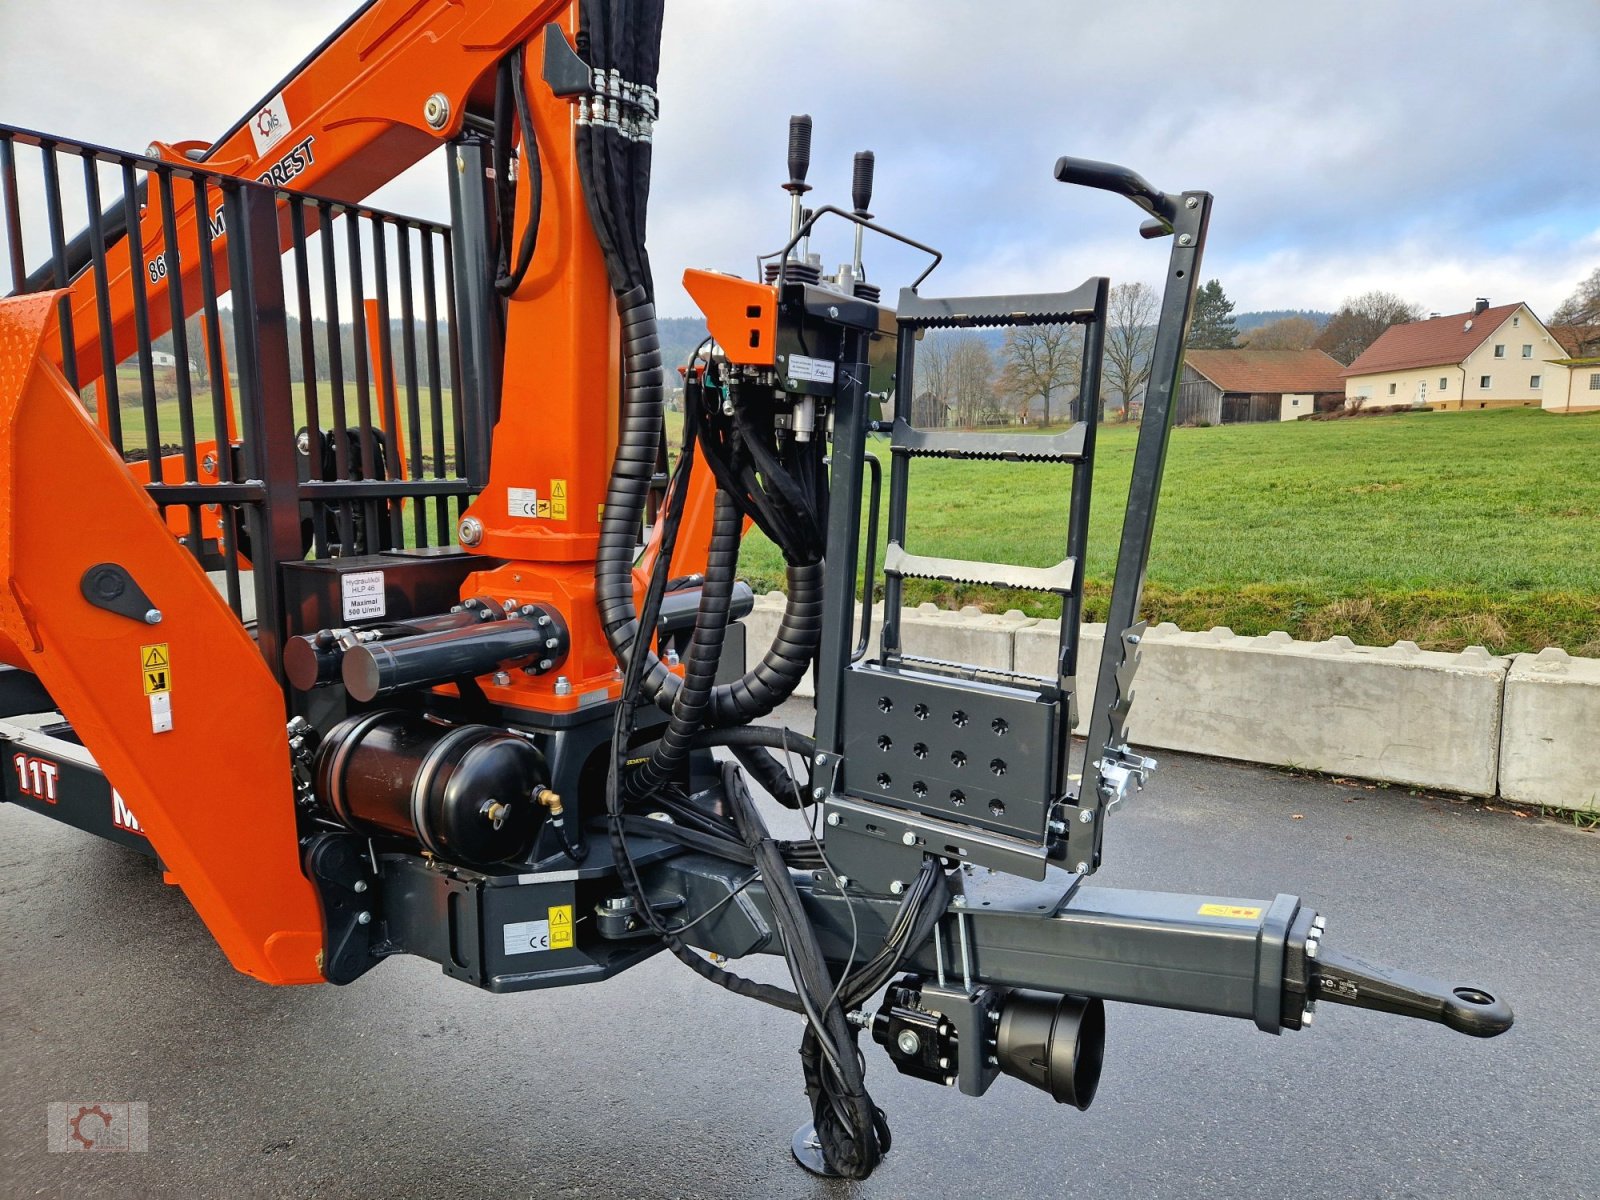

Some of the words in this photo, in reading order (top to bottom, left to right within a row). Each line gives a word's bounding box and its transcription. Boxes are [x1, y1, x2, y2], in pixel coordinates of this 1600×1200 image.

[351, 586, 366, 594] HLP
[350, 598, 378, 607] Maximal
[348, 608, 361, 616] 500
[361, 606, 381, 614] U/min
[13, 752, 59, 805] 11T
[529, 934, 548, 949] CE
